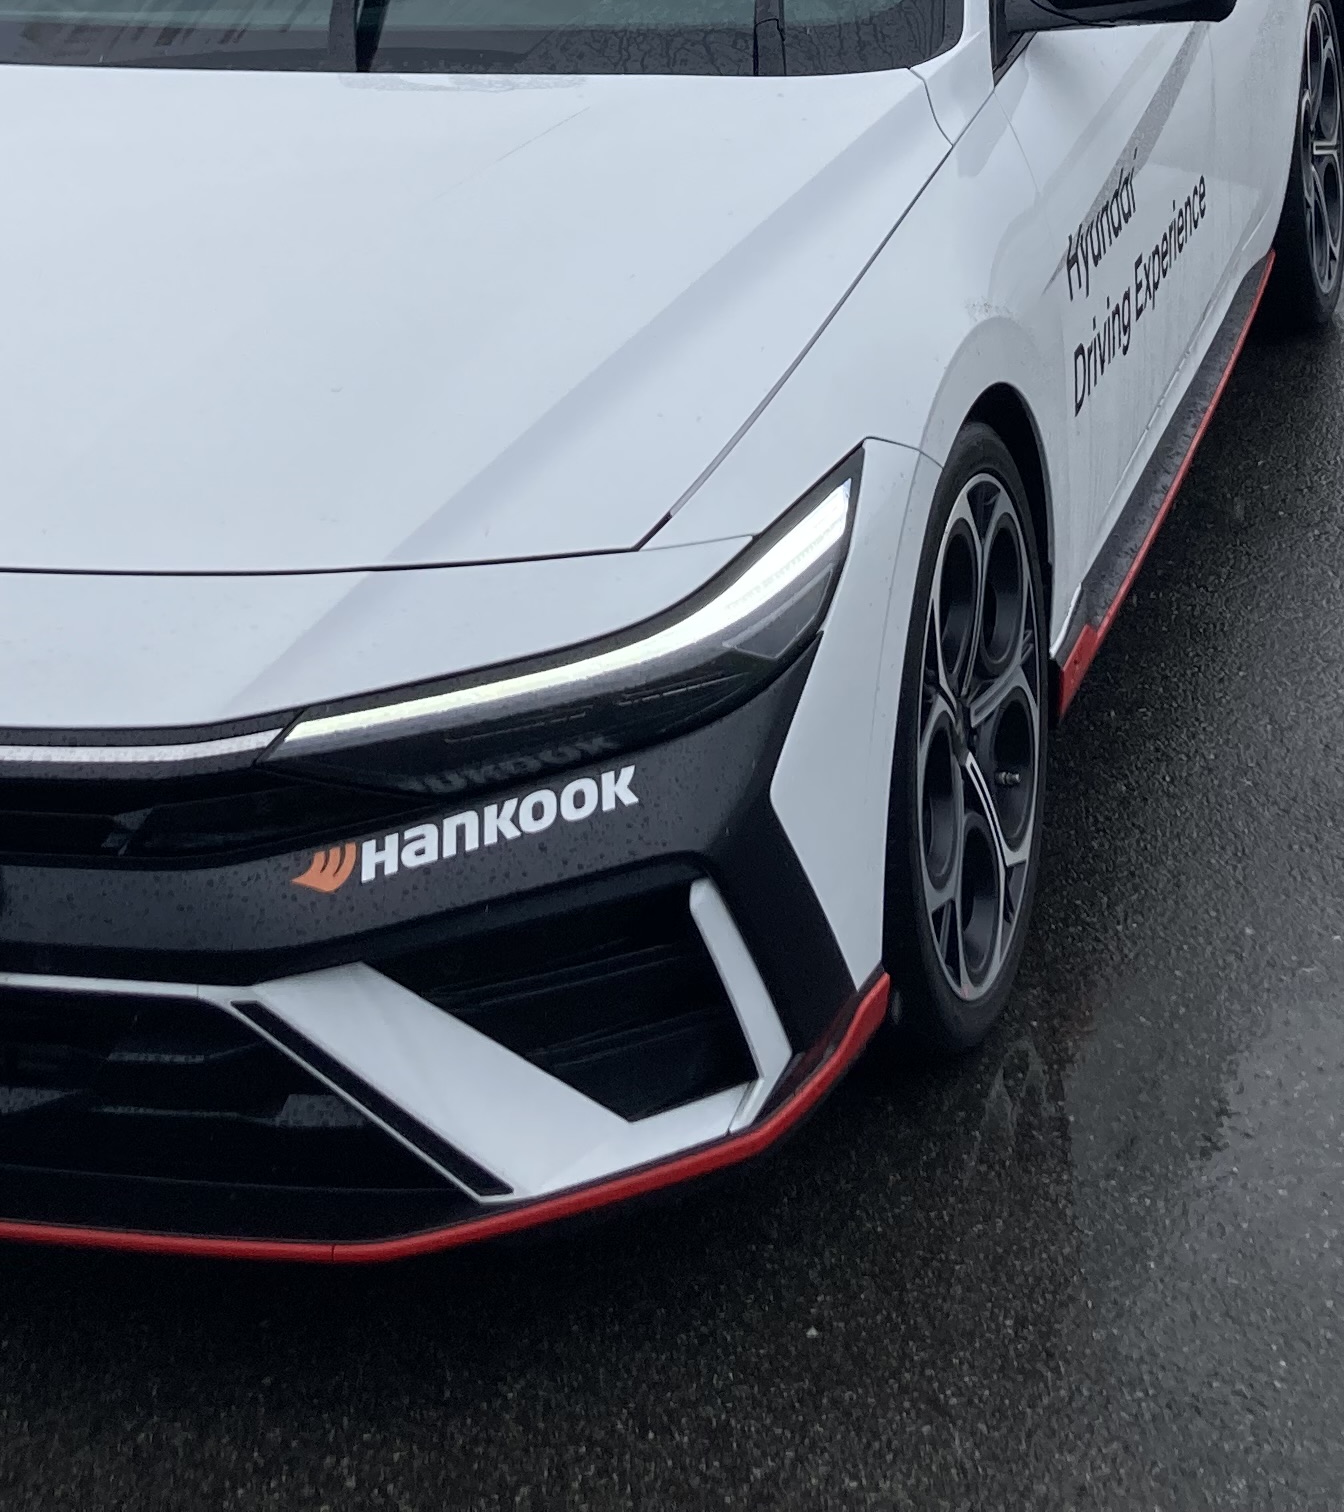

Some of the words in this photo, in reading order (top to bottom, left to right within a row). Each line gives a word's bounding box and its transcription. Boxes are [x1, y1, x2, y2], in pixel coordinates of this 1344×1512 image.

[1067, 147, 1137, 302] Hyundai
[1074, 287, 1131, 418] Driving
[1134, 175, 1206, 321] Experience
